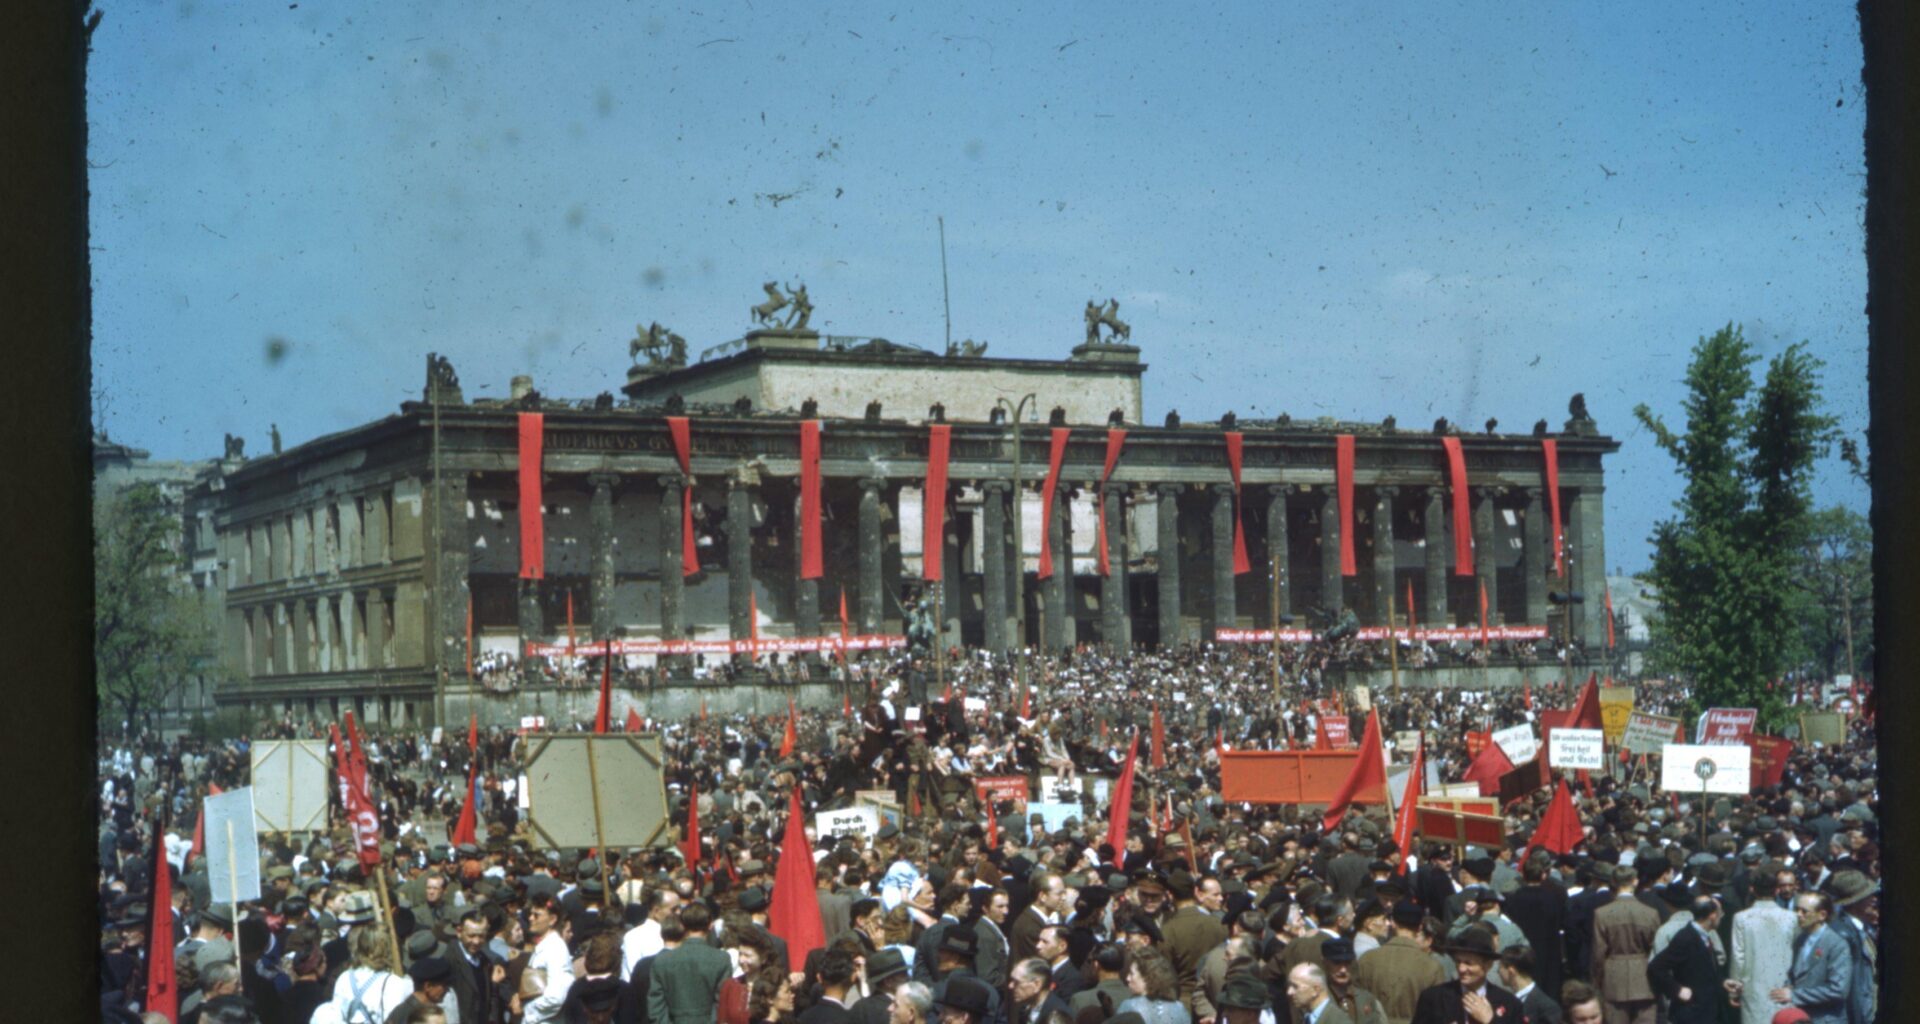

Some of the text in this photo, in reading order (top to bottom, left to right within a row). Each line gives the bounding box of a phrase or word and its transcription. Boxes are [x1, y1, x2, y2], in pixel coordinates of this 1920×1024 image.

[540, 433, 638, 449] RIDERICVS
[670, 641, 687, 652] und
[1559, 755, 1574, 763] und
[833, 814, 863, 825] Durch
